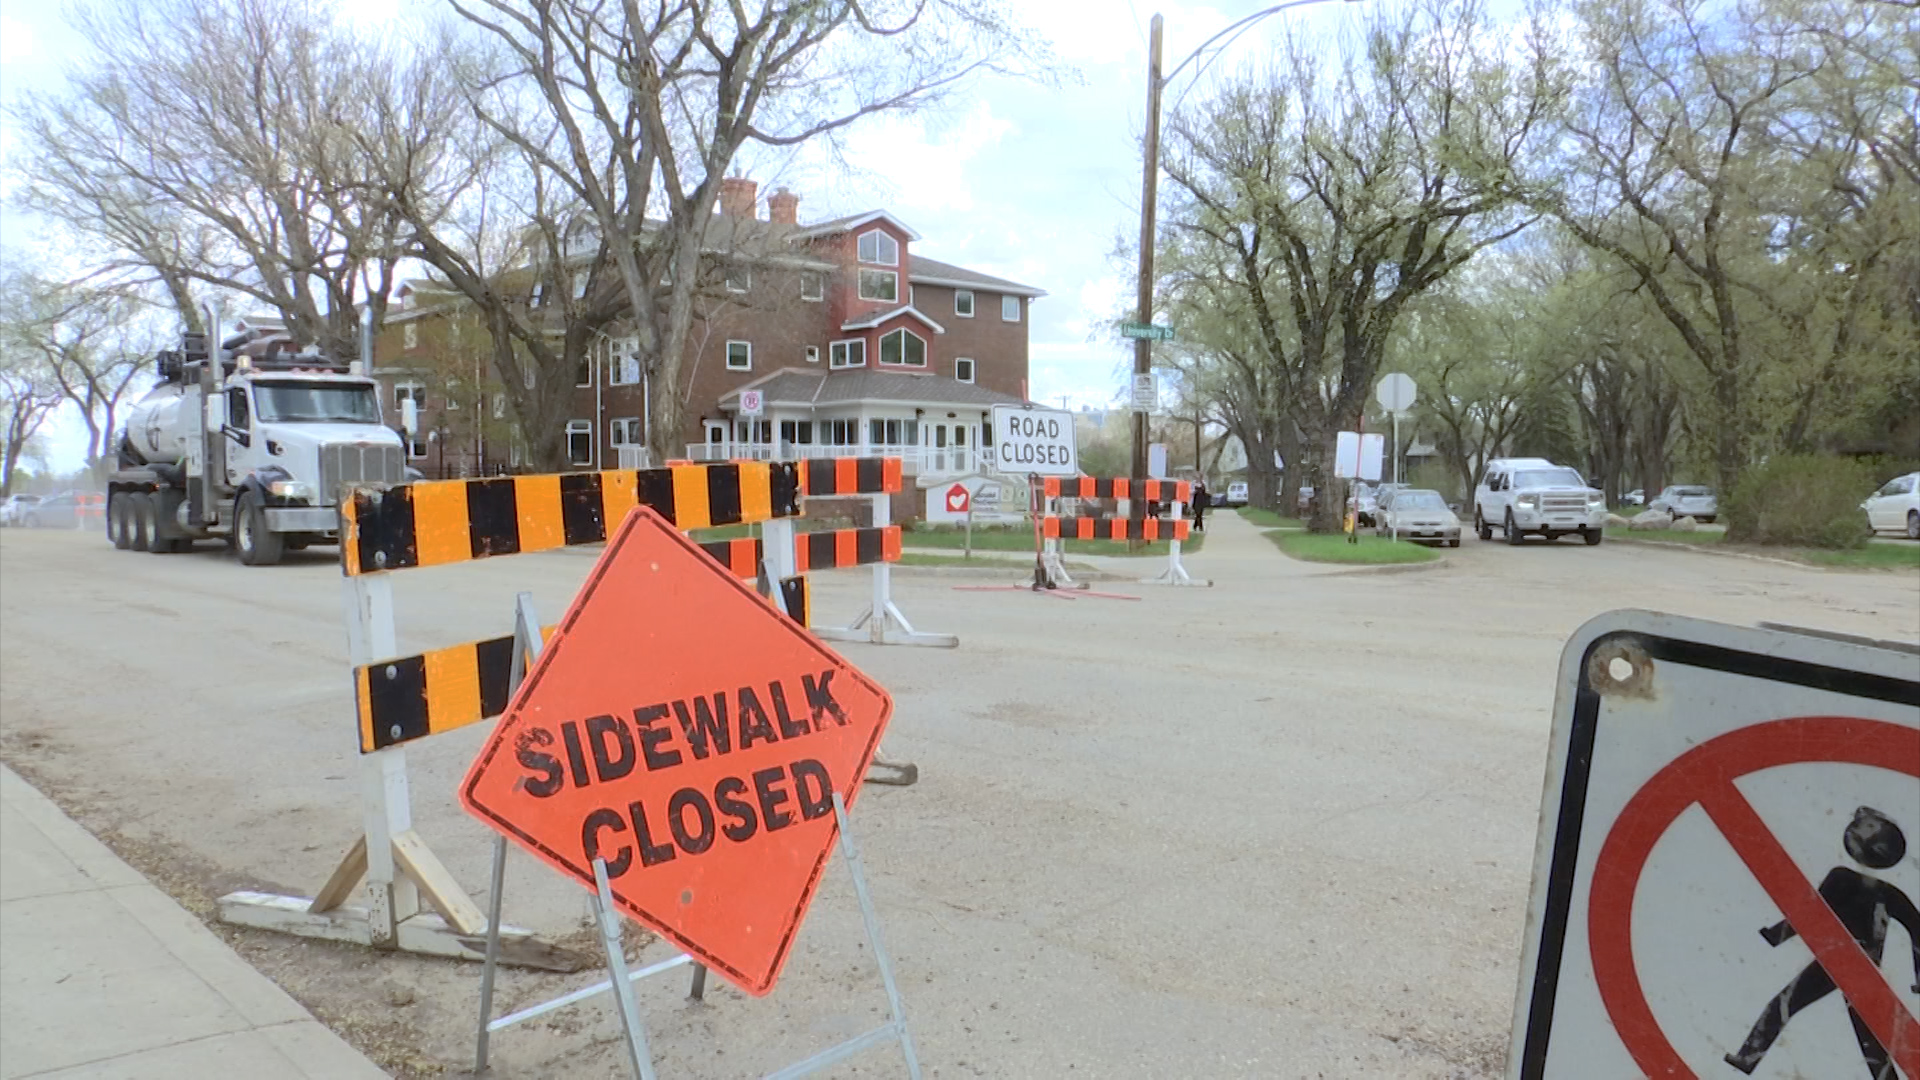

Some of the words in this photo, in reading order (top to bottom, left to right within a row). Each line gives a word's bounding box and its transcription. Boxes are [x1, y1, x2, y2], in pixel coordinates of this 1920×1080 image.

[1002, 442, 1069, 465] CLOSED
[1010, 416, 1059, 438] ROAD
[514, 670, 851, 797] SIDEWALK
[582, 758, 836, 879] CLOSED
